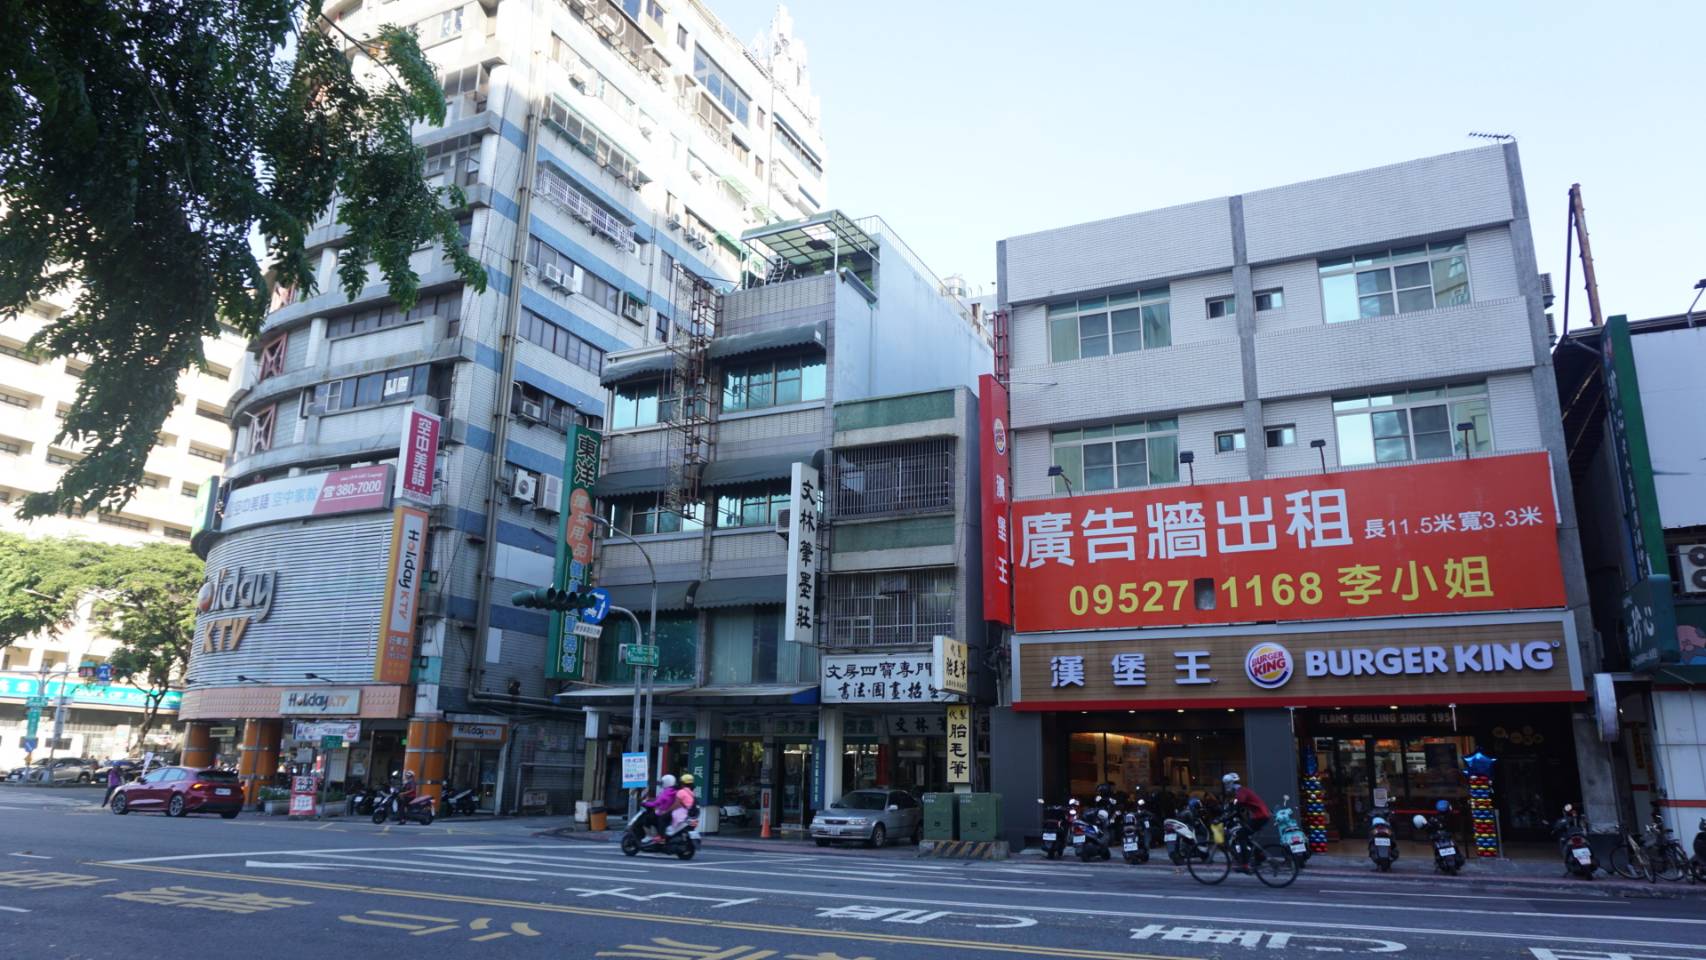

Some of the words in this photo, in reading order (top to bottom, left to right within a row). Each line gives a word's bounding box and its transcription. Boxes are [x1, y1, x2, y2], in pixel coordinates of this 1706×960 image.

[411, 417, 433, 487] 空中美語
[574, 434, 598, 488] 東洋
[335, 480, 381, 496] 380-7000
[996, 474, 1008, 585] 漢堡王
[1019, 488, 1354, 569] 廣告牆出租
[399, 529, 420, 592] Holiday
[795, 480, 816, 629] 文林筆墨莊
[1337, 555, 1494, 606] 李小姐
[399, 590, 410, 620] KTV
[203, 616, 249, 653] KTV
[946, 657, 966, 679] 胎毛筆
[1050, 651, 1212, 688] 漢堡王
[1252, 651, 1284, 668] BURGER
[1254, 658, 1286, 676] KING
[1305, 645, 1449, 677] BURGER
[1453, 641, 1554, 673] KING
[288, 692, 328, 711] Holiday
[328, 695, 347, 707] KTV
[949, 709, 968, 720] 代製
[1319, 713, 1349, 724] FLAME
[1353, 712, 1397, 724] GRILLING
[1400, 712, 1427, 724] SINCE
[949, 724, 968, 779] 胎毛筆
